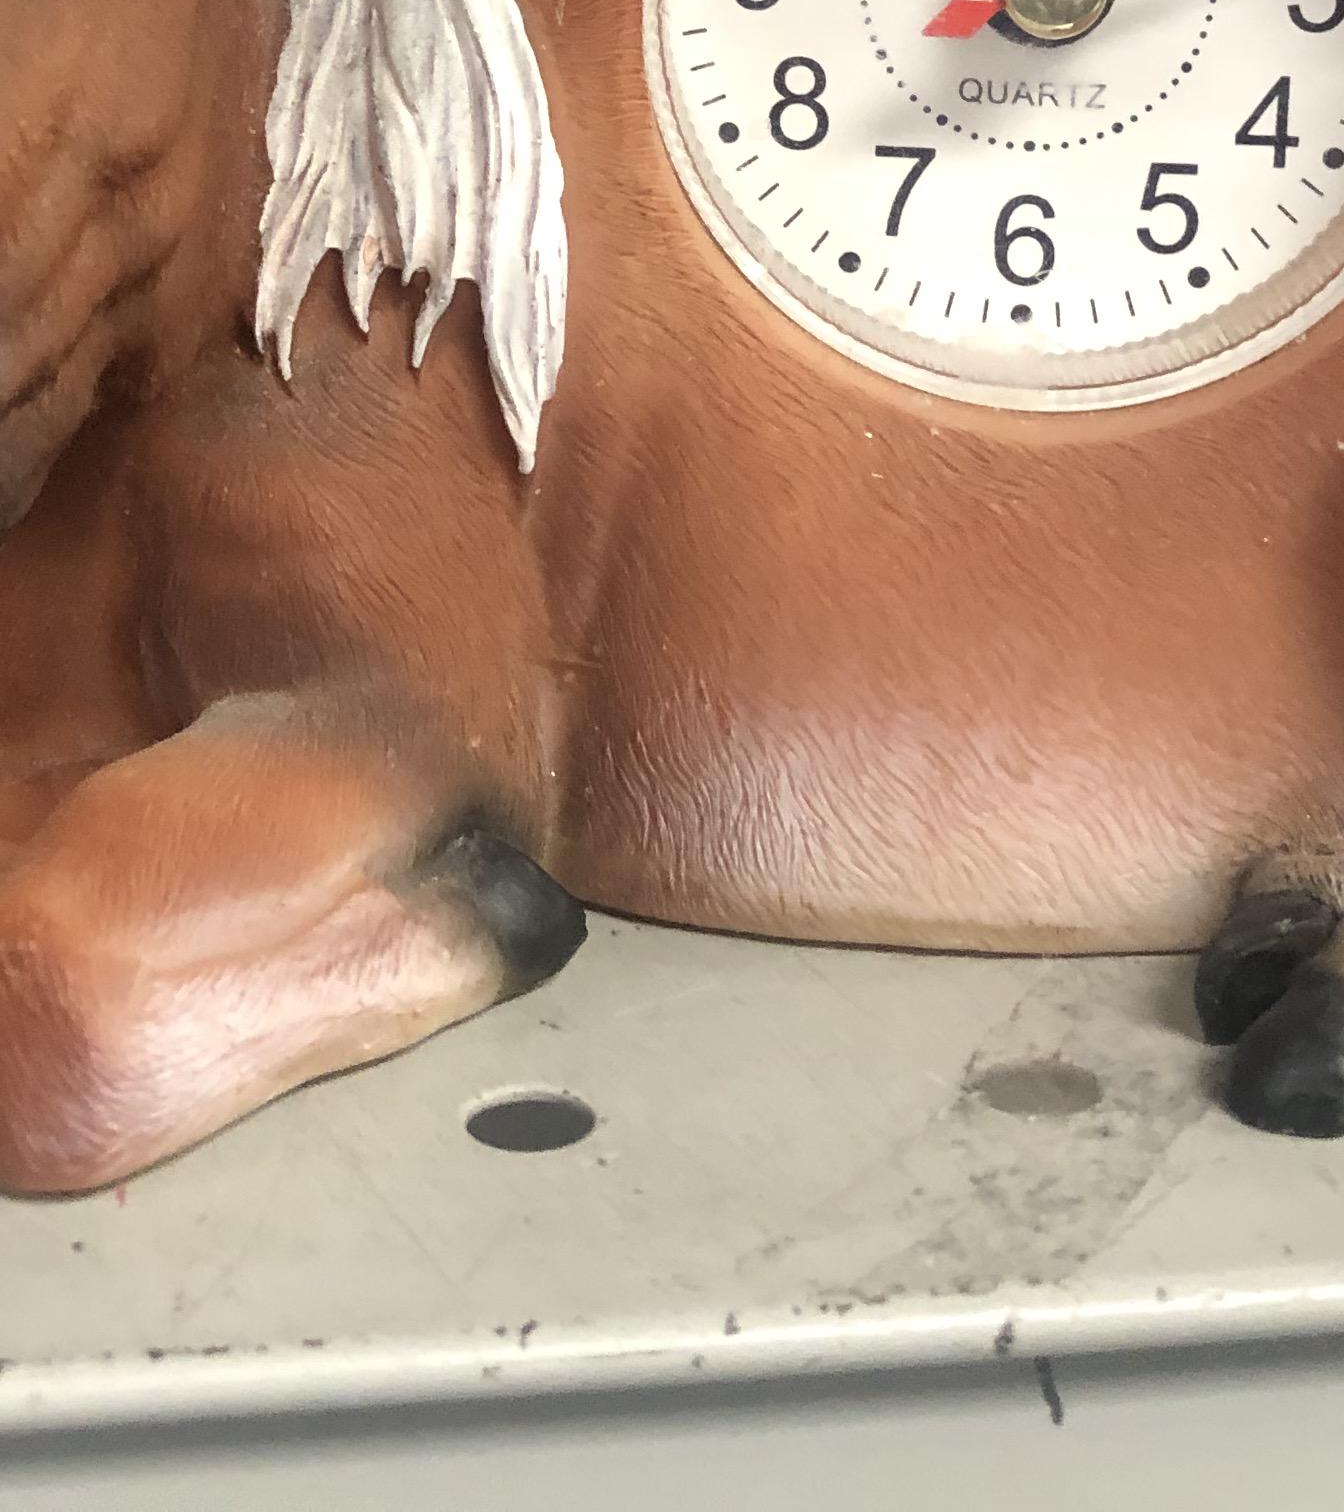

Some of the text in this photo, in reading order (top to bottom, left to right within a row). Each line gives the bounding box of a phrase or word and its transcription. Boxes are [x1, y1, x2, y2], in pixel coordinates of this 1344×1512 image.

[767, 56, 830, 152] 8
[957, 77, 1110, 111] QUARTZ
[1234, 75, 1300, 171] 4
[873, 144, 937, 238] 7
[1135, 162, 1202, 256] 5
[992, 193, 1058, 287] 6
